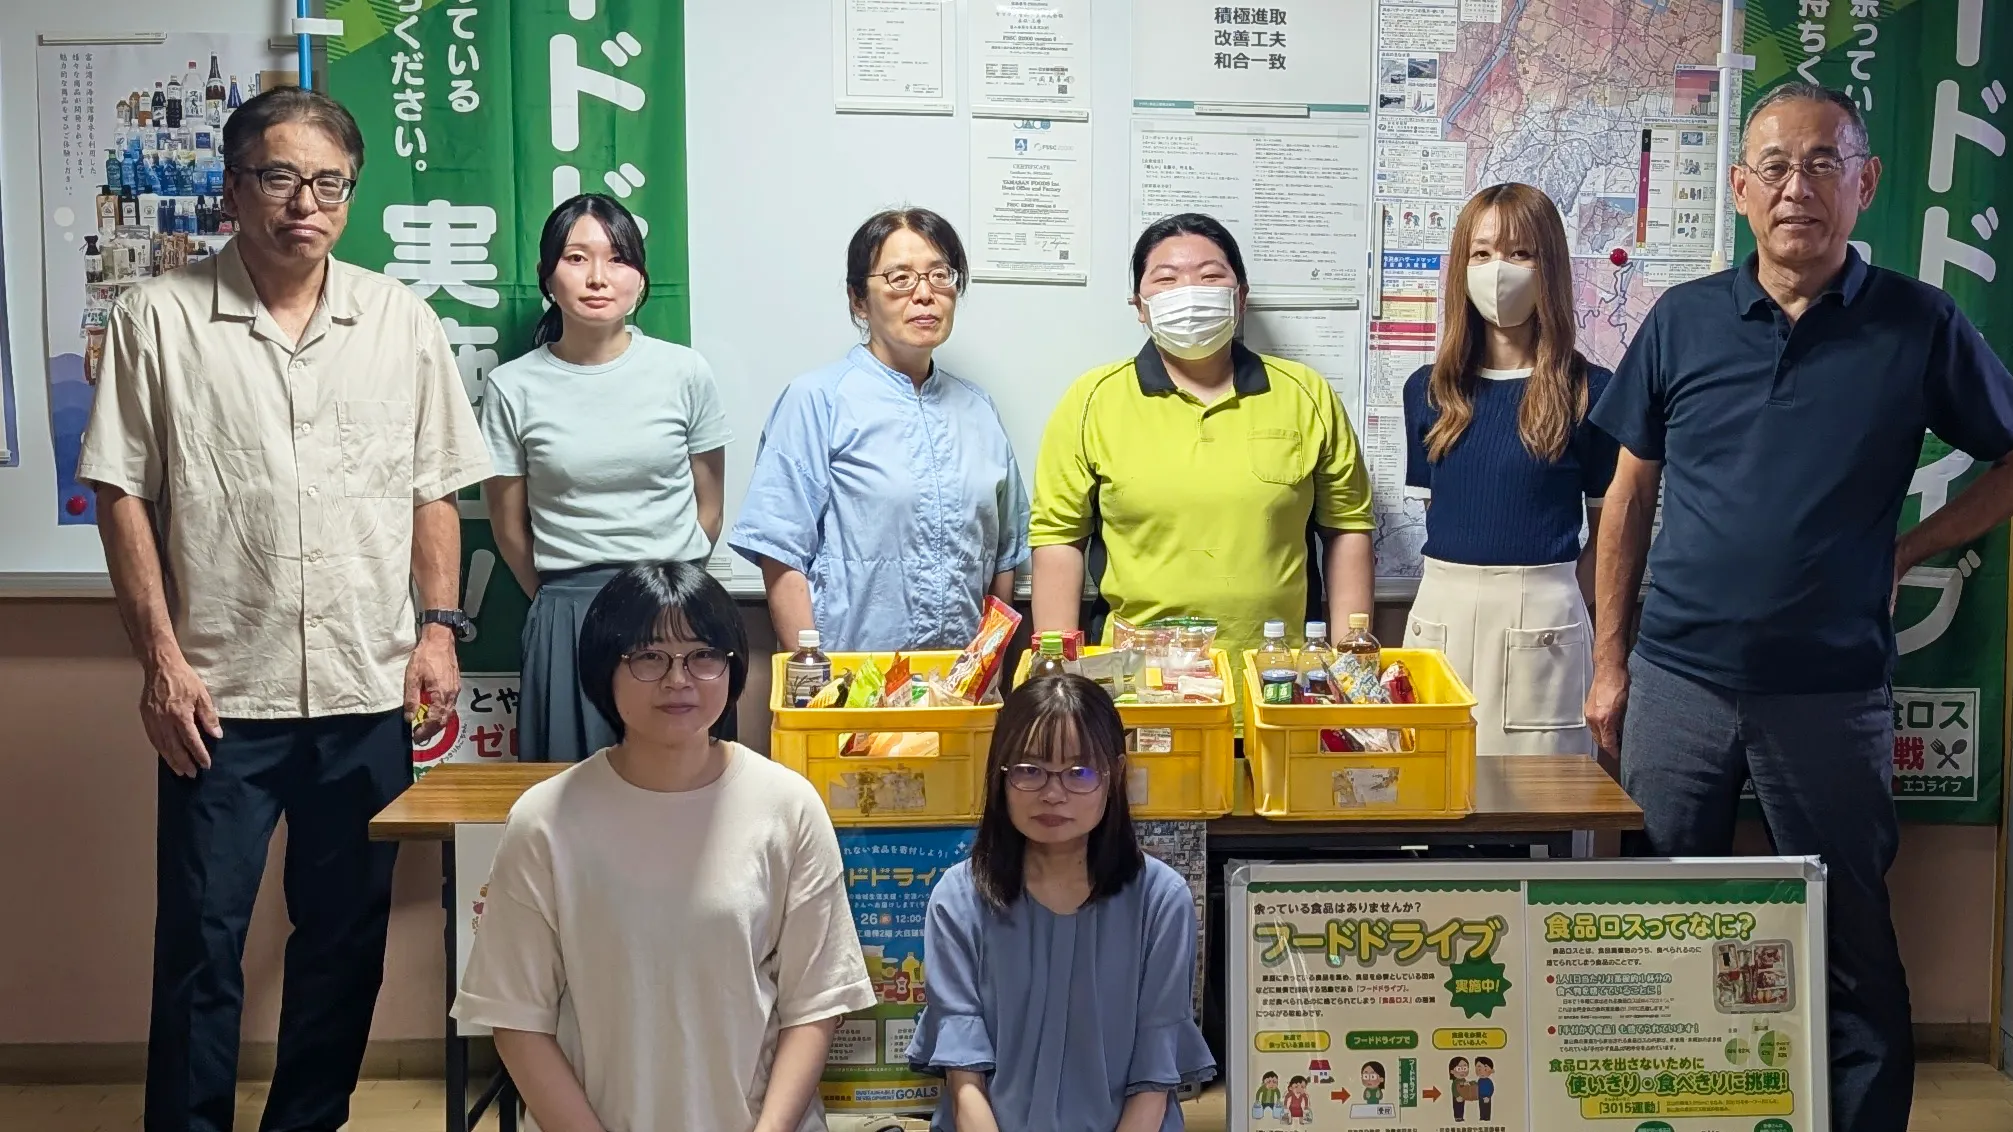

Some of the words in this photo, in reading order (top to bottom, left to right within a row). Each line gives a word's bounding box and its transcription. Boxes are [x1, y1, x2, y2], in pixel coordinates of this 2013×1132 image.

[1214, 7, 1287, 25] 積極進取
[1214, 30, 1287, 47] 改善工夫
[447, 0, 480, 113] ている
[1214, 52, 1287, 70] 和合一致
[1904, 780, 1962, 792] エコライフ
[1545, 913, 1755, 941] 食品ロスってなに?
[1255, 917, 1504, 963] フードドライブ
[1455, 979, 1500, 993] 実施中!
[1353, 1036, 1411, 1045] フードドライブで
[1549, 1057, 1705, 1072] 食品ロスを出さないために
[895, 1086, 938, 1100] GOALS
